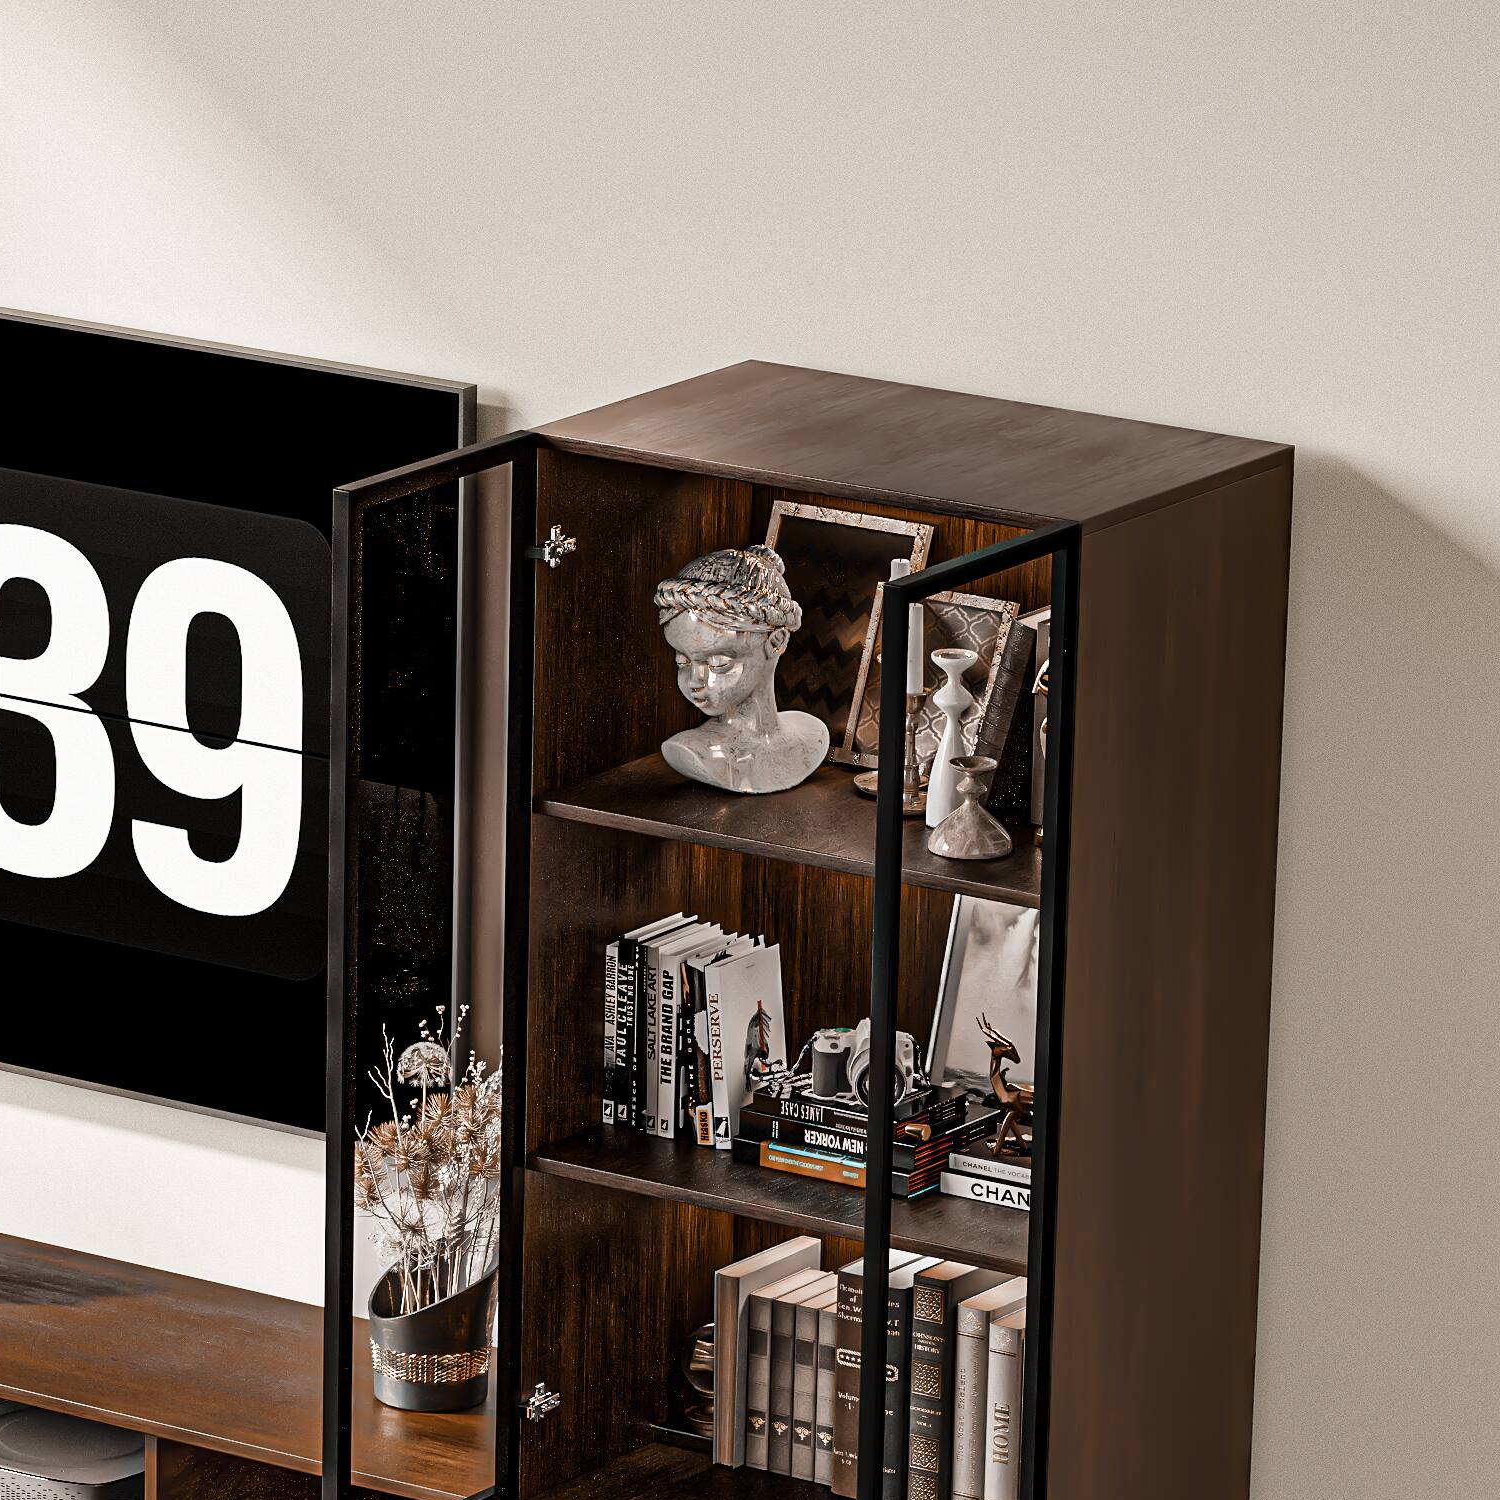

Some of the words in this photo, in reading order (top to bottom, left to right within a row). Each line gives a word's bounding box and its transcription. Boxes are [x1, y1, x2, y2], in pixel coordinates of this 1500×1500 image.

[606, 955, 618, 992] BARRON
[627, 964, 635, 981] ONE
[648, 965, 657, 992] ART
[662, 969, 674, 1001] GAP
[617, 963, 628, 1023] CLEAVE
[627, 985, 634, 996] NO
[605, 993, 617, 1026] ASHLEY
[626, 1000, 634, 1027] TRUST
[647, 993, 657, 1027] LAKE
[660, 1003, 674, 1056] BRAND
[709, 993, 724, 1082] PERSERVE
[604, 1036, 615, 1053] AVA
[616, 1027, 627, 1067] PAUL
[647, 1028, 656, 1061] SALT
[660, 1057, 673, 1086] THE
[780, 1100, 799, 1118] CASE
[801, 1105, 824, 1123] JAMES
[804, 1128, 842, 1150] YORKER
[841, 1137, 864, 1155] NEW
[962, 1161, 992, 1173] CHANEL
[1007, 1170, 1031, 1180] VOCAB
[993, 1402, 1011, 1465] HOME
